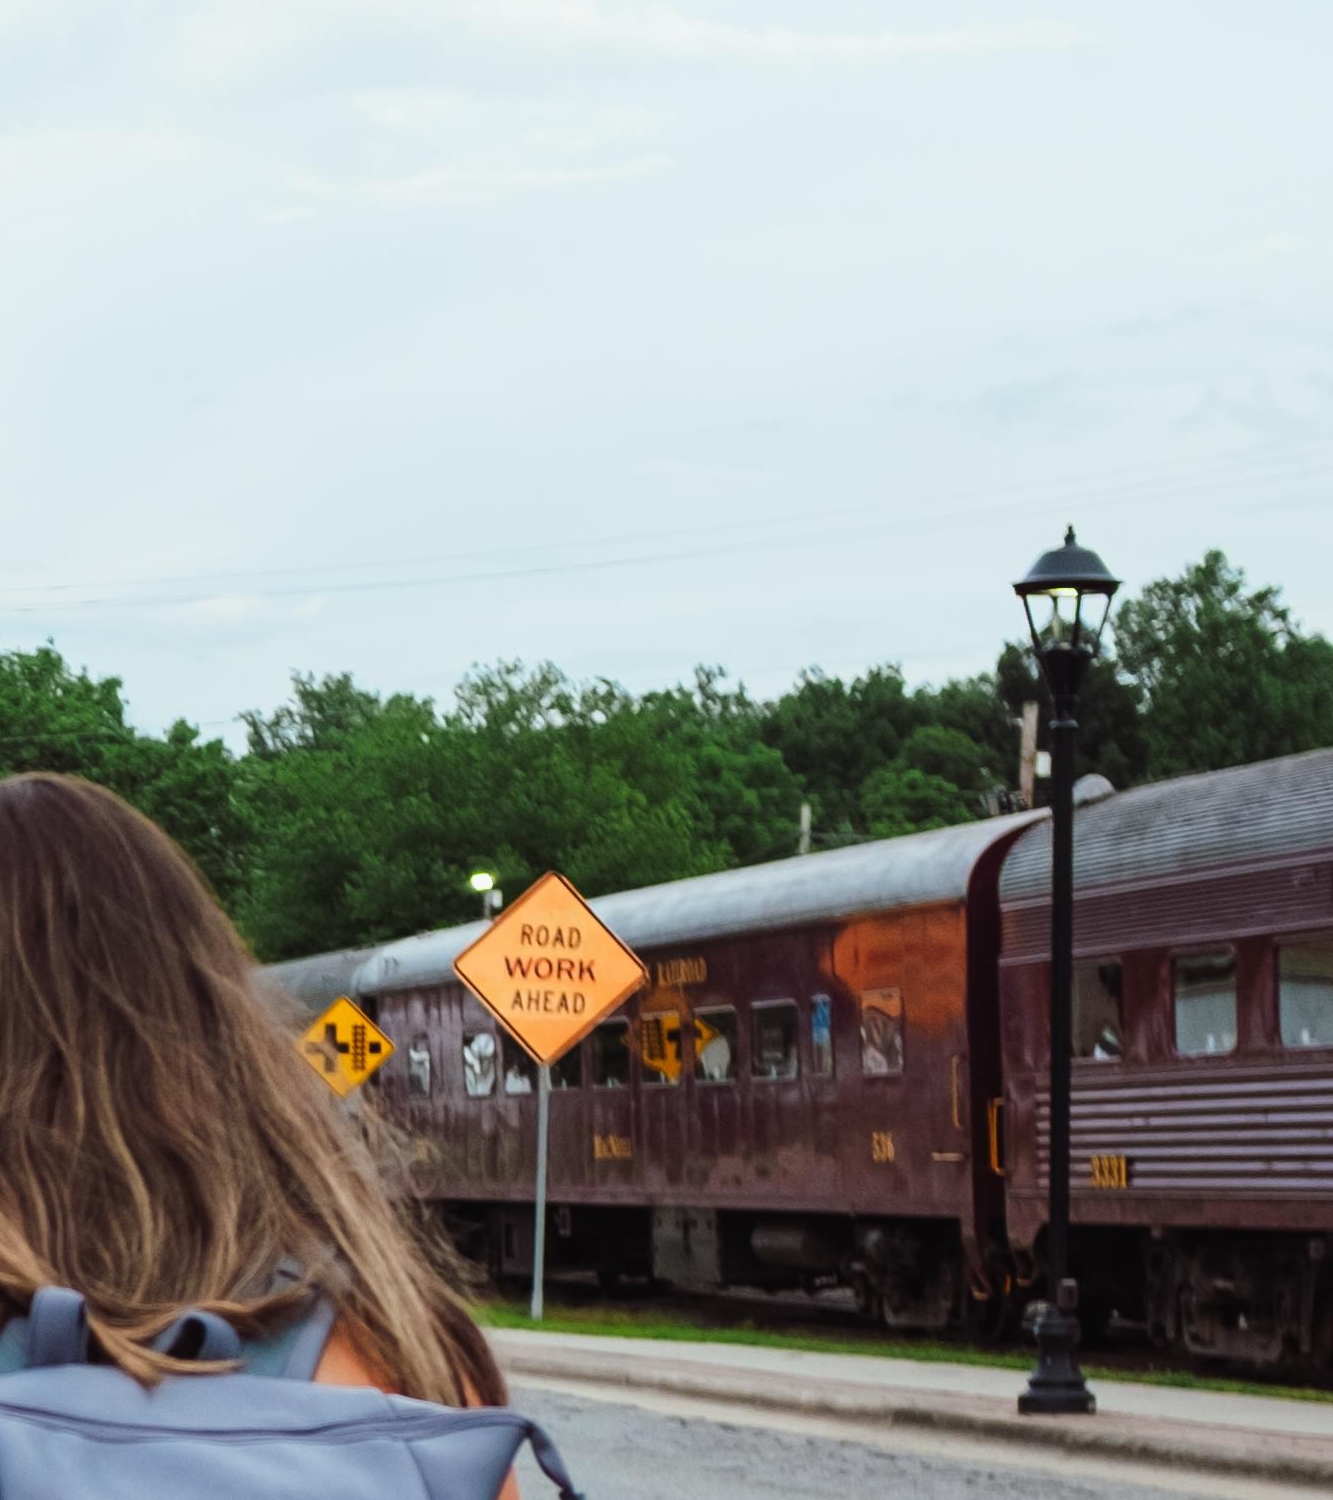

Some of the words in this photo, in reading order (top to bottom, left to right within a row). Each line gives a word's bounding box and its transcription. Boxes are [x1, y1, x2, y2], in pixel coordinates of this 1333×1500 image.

[520, 923, 582, 949] ROAD
[504, 955, 597, 982] WORK
[511, 989, 586, 1015] AHEAD
